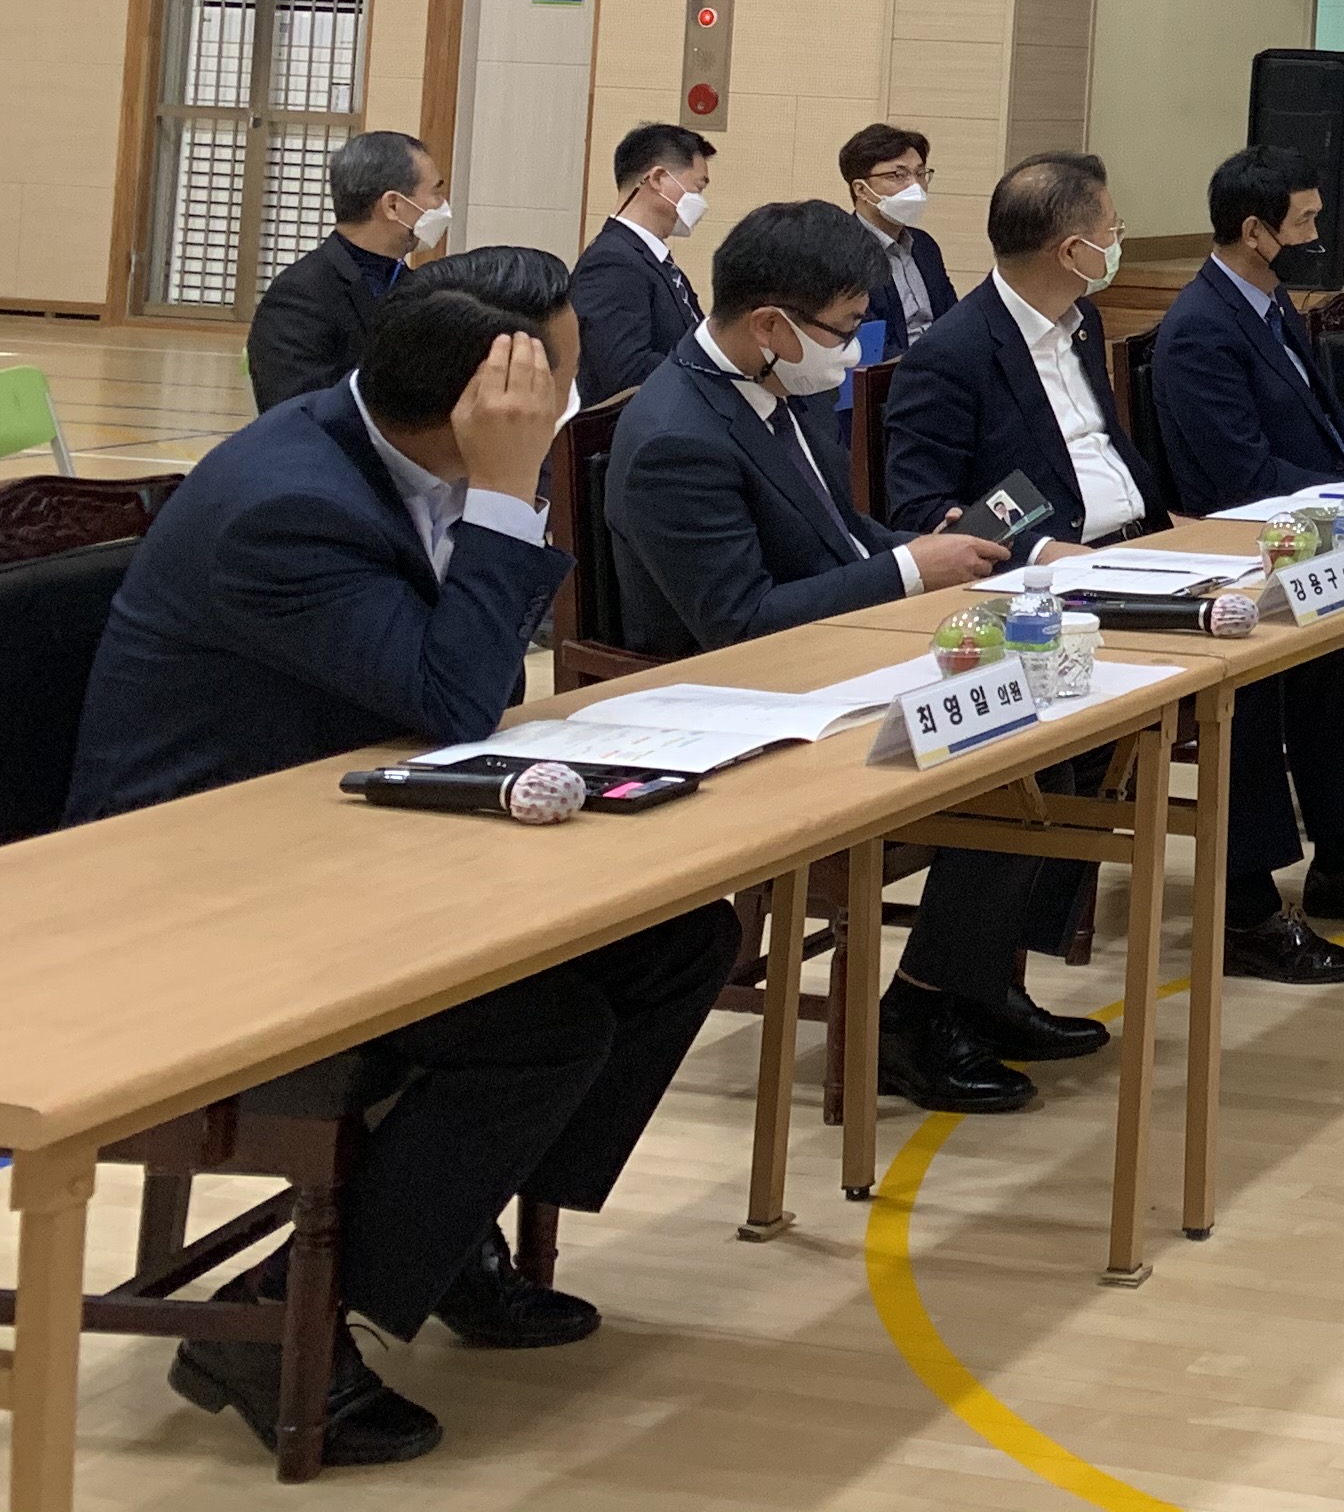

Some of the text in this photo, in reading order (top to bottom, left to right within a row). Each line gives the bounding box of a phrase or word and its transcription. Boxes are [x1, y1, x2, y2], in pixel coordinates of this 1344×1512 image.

[1289, 567, 1338, 601] 강용구
[916, 680, 1023, 734] 최영일 의원
